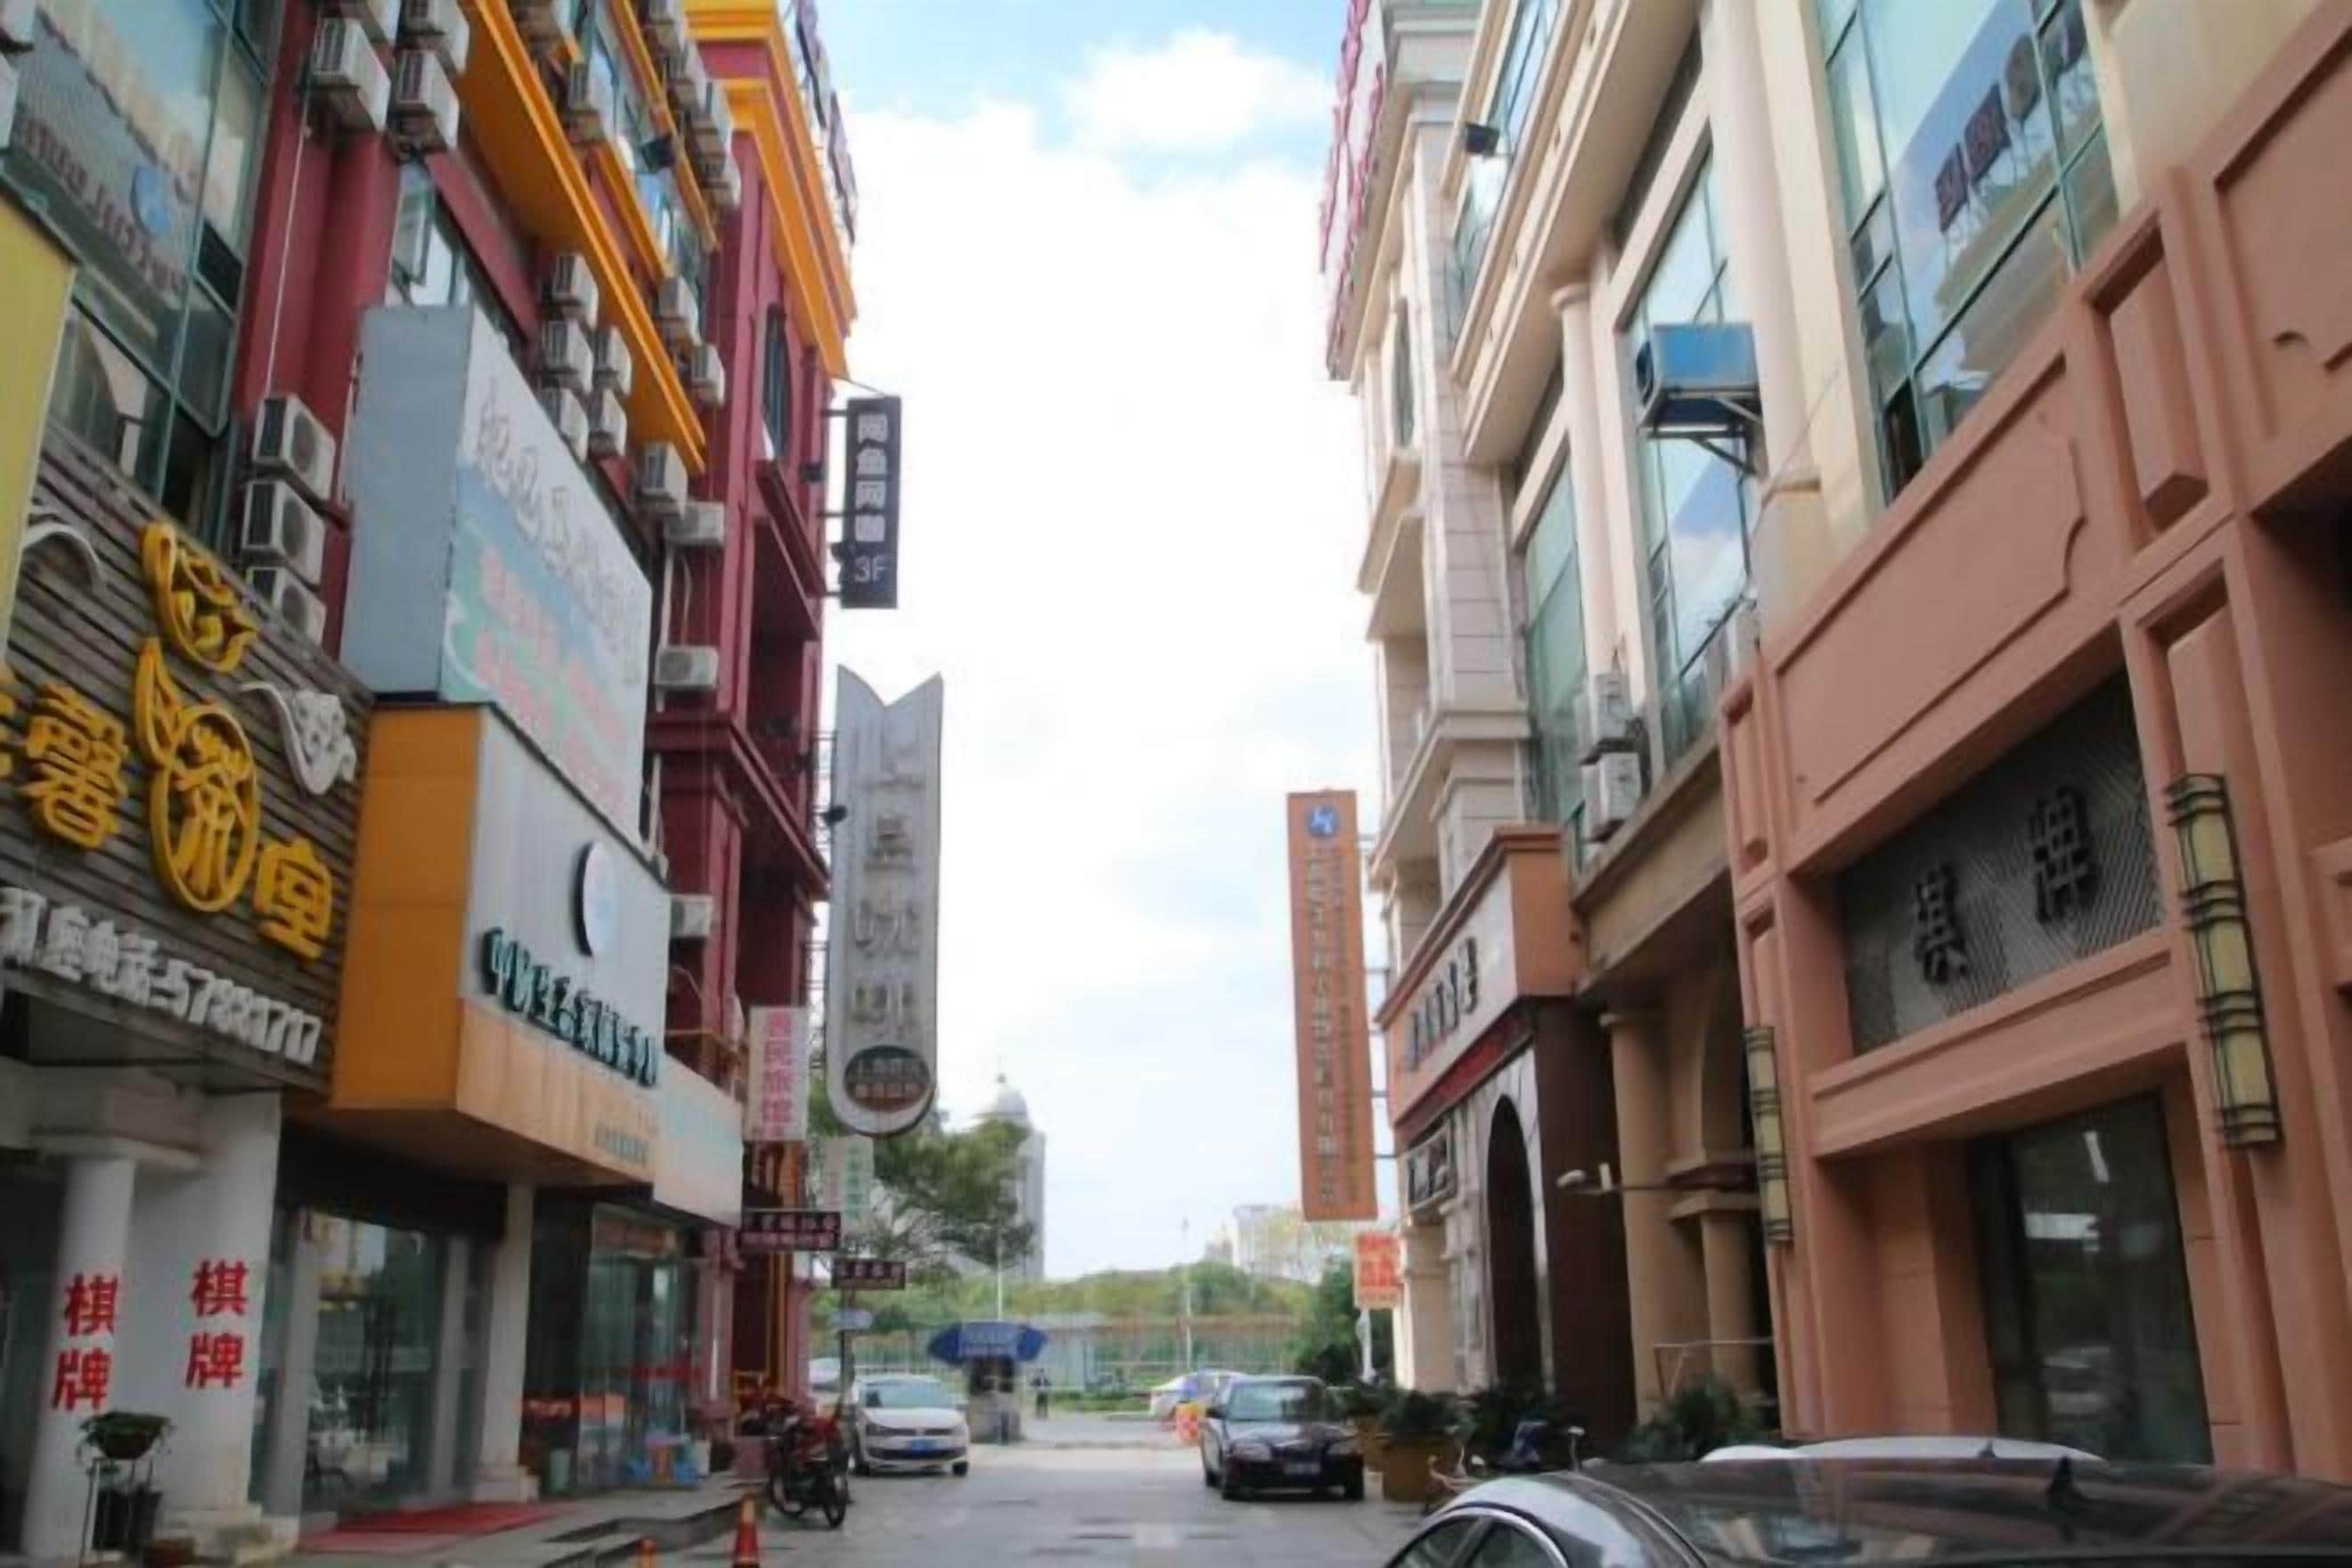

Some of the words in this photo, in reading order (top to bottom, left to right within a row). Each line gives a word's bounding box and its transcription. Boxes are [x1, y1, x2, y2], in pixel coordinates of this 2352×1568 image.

[854, 554, 889, 583] 3F
[52, 1271, 118, 1412] 棋牌
[186, 1259, 249, 1391] 棋牌
